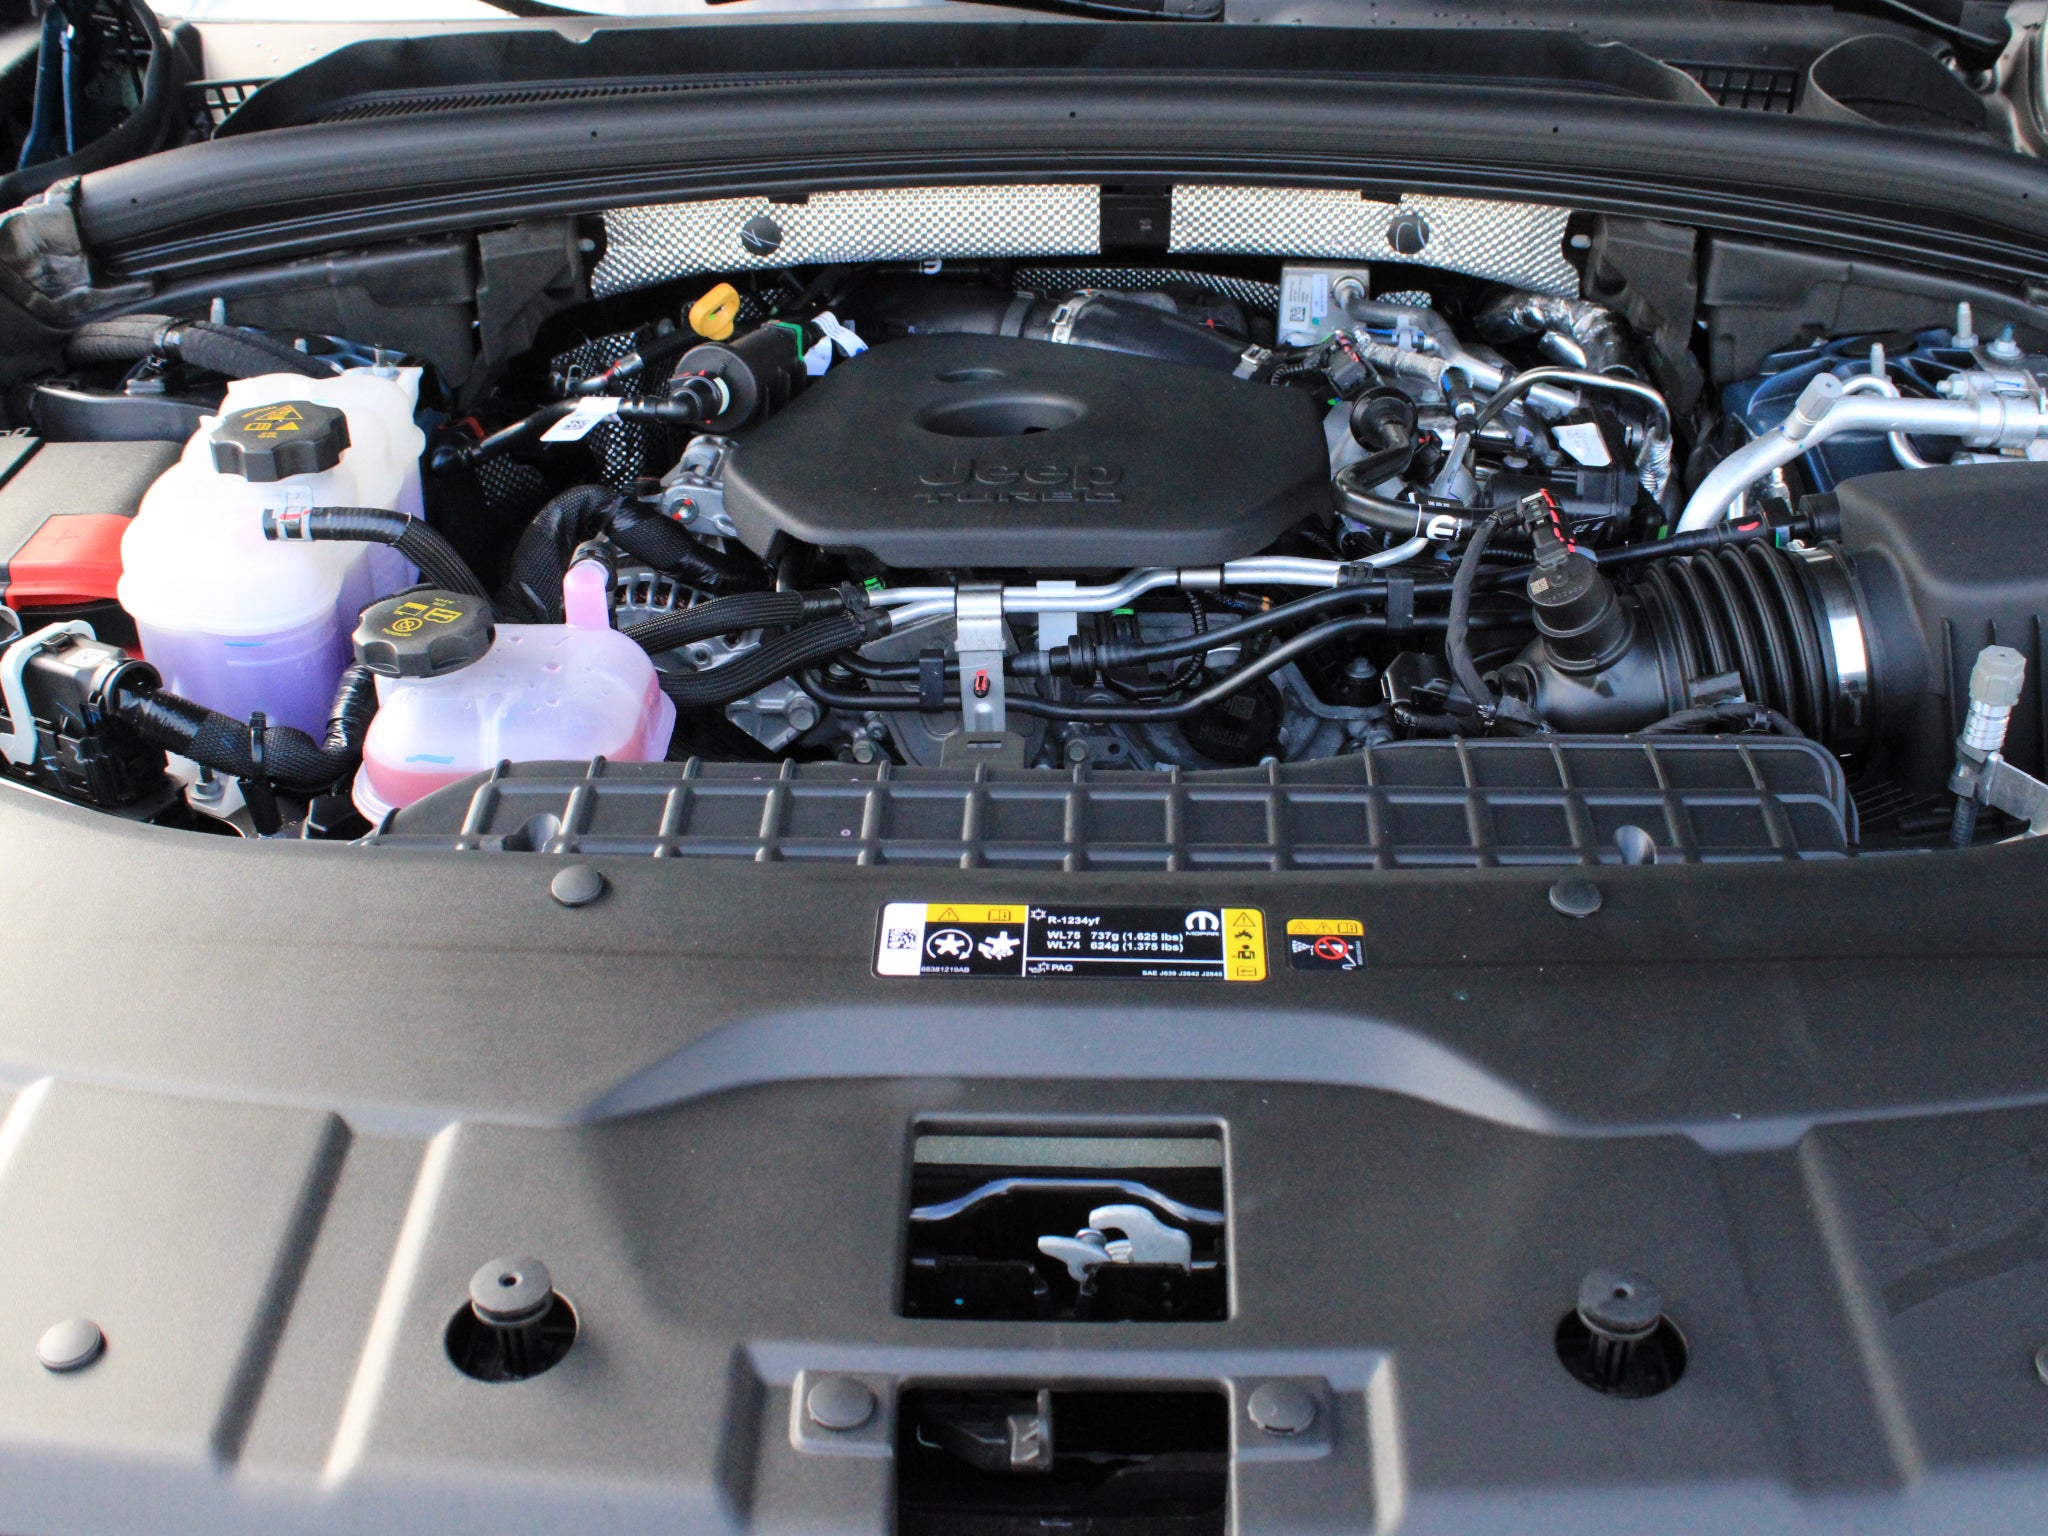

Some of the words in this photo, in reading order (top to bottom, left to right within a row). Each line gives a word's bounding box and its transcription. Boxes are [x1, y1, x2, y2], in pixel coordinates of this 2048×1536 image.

[919, 459, 1123, 491] Jeep
[914, 492, 1123, 502] TURBO
[1048, 916, 1100, 926] R-1234yf
[1047, 931, 1081, 940] WL75
[1091, 931, 1120, 941] 737g
[1123, 932, 1158, 942] (1.625
[1161, 933, 1183, 942] lbs)
[1047, 941, 1080, 949] WL74
[1091, 941, 1119, 951] 624g
[1123, 942, 1158, 951] (1.375
[1161, 943, 1184, 952] lbs)
[1051, 964, 1073, 972] PAG
